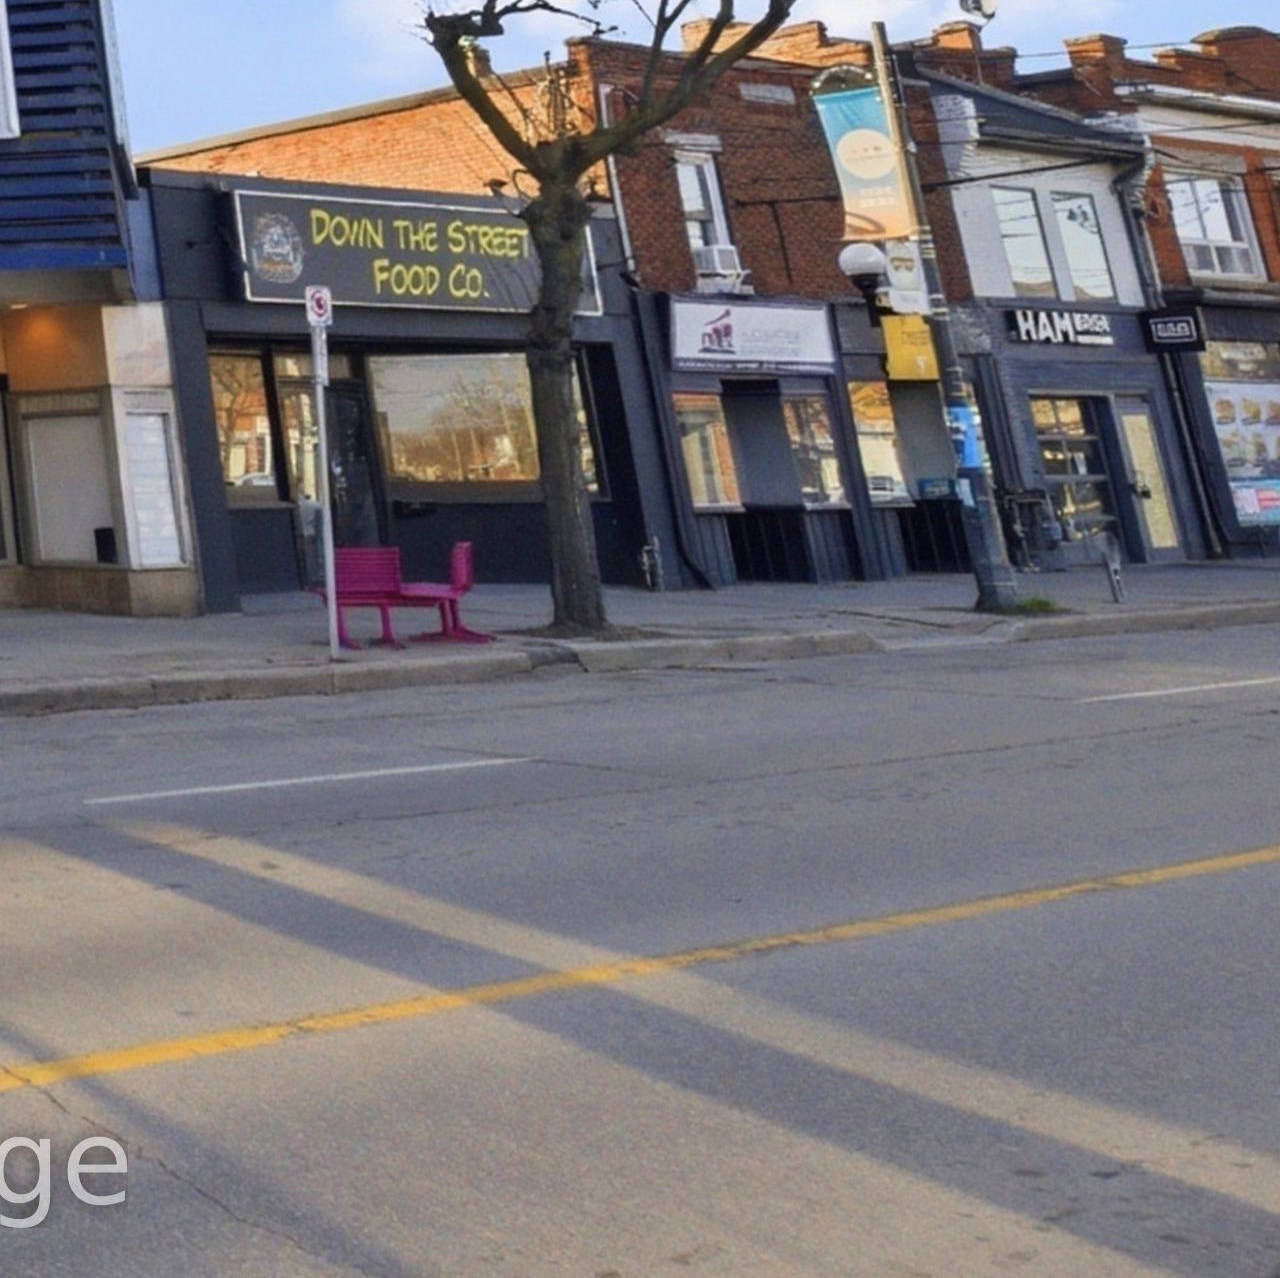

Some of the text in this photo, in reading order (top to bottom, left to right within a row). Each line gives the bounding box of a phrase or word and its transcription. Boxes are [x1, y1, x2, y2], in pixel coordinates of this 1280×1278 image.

[392, 219, 438, 253] THE
[447, 219, 530, 259] STREET
[372, 258, 491, 299] FOOD CO.
